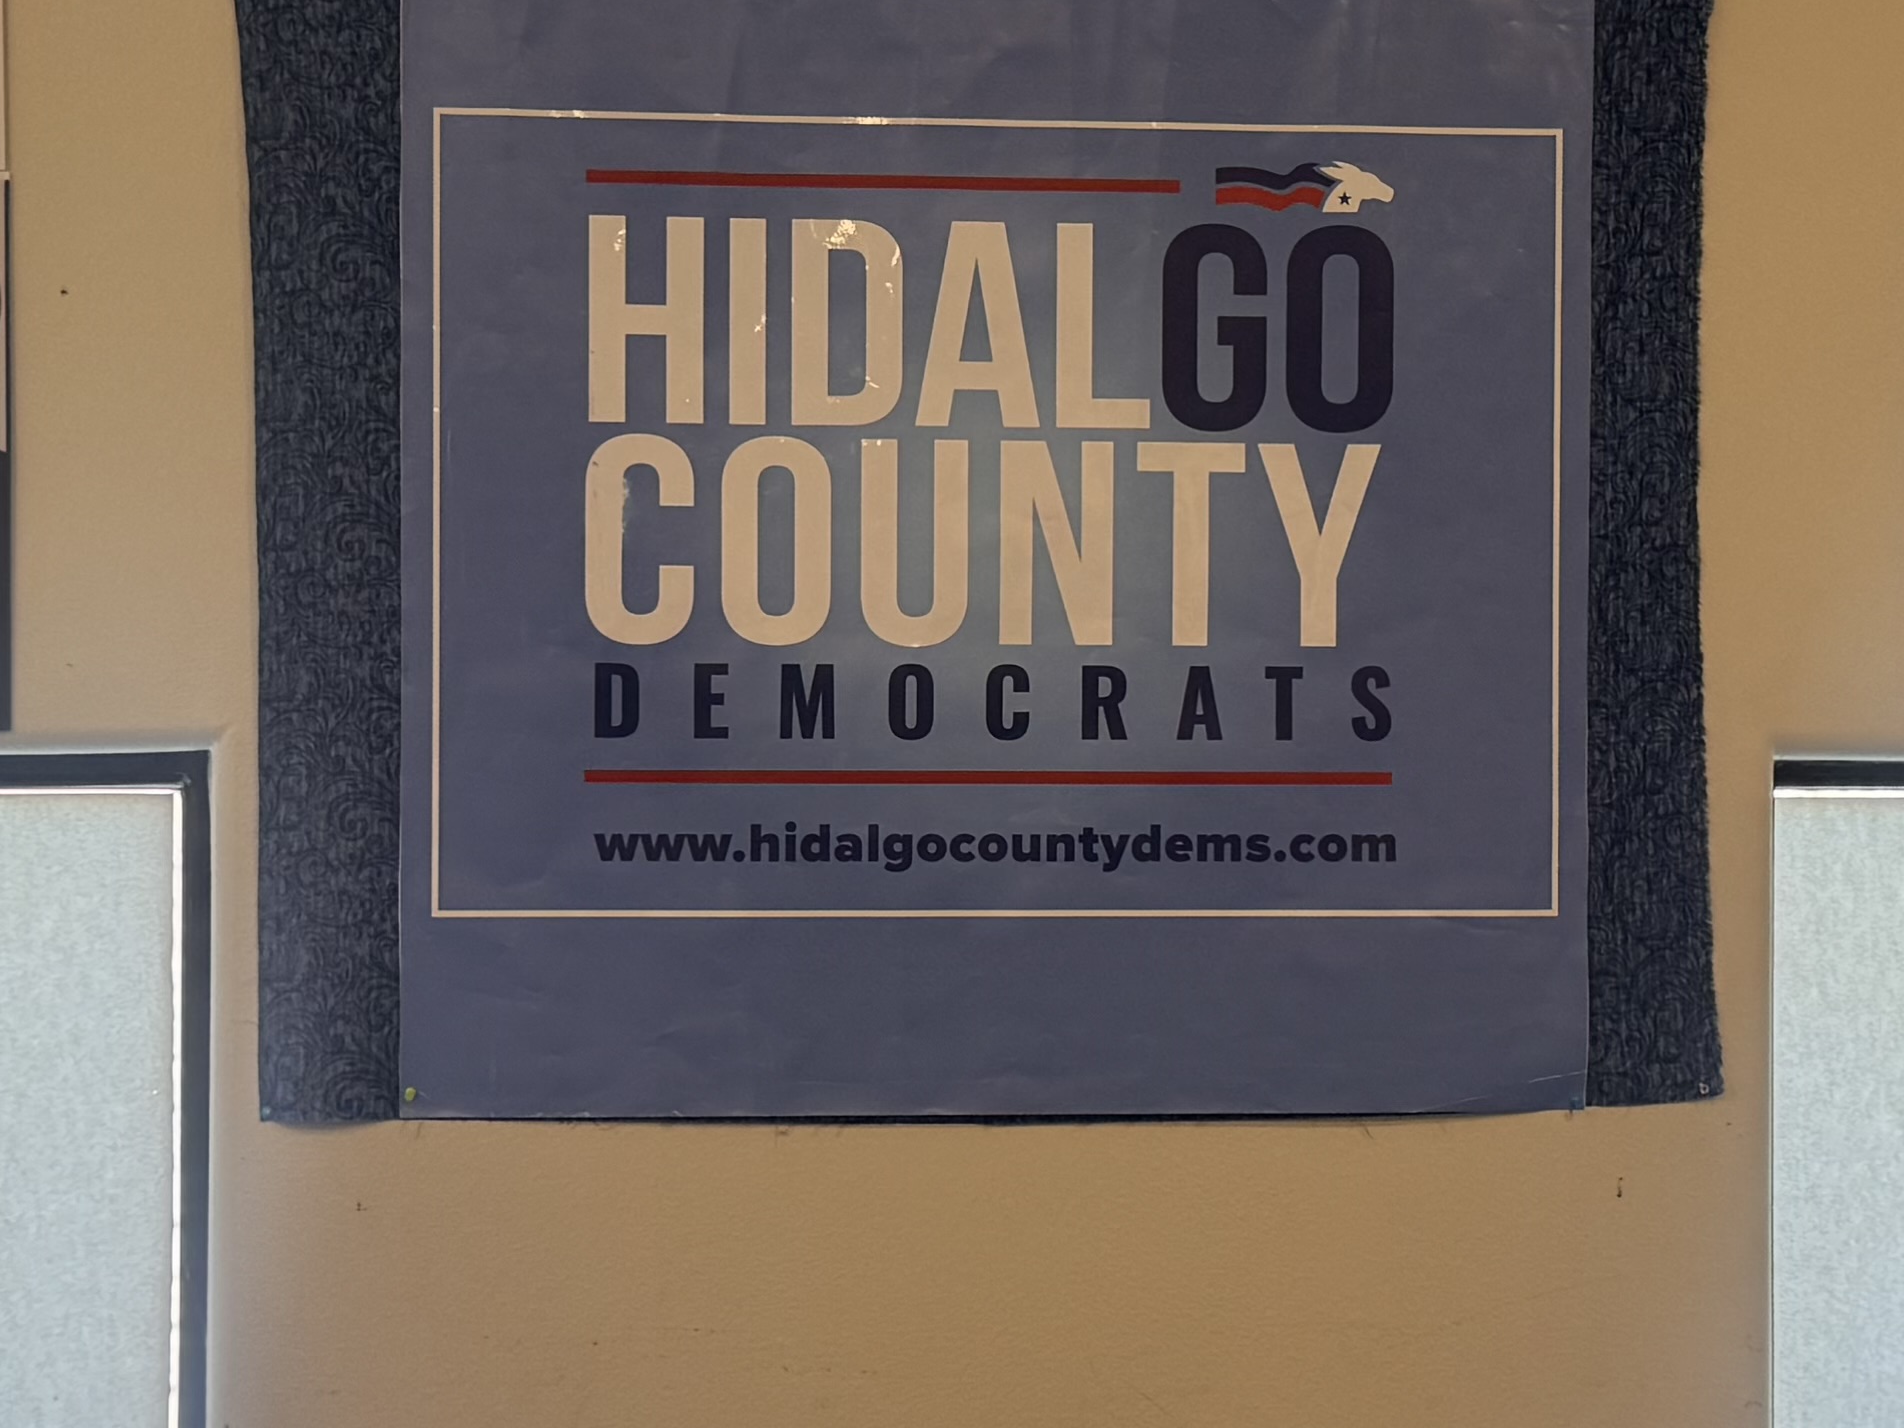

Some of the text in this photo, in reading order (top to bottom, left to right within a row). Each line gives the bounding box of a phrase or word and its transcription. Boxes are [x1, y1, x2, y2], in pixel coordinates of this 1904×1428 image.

[585, 214, 1396, 433] HIDALGO
[582, 432, 1384, 648] COUNTY
[593, 662, 1395, 742] DEMOCRATS
[593, 821, 1399, 876] www.hidalgocountydems.com
